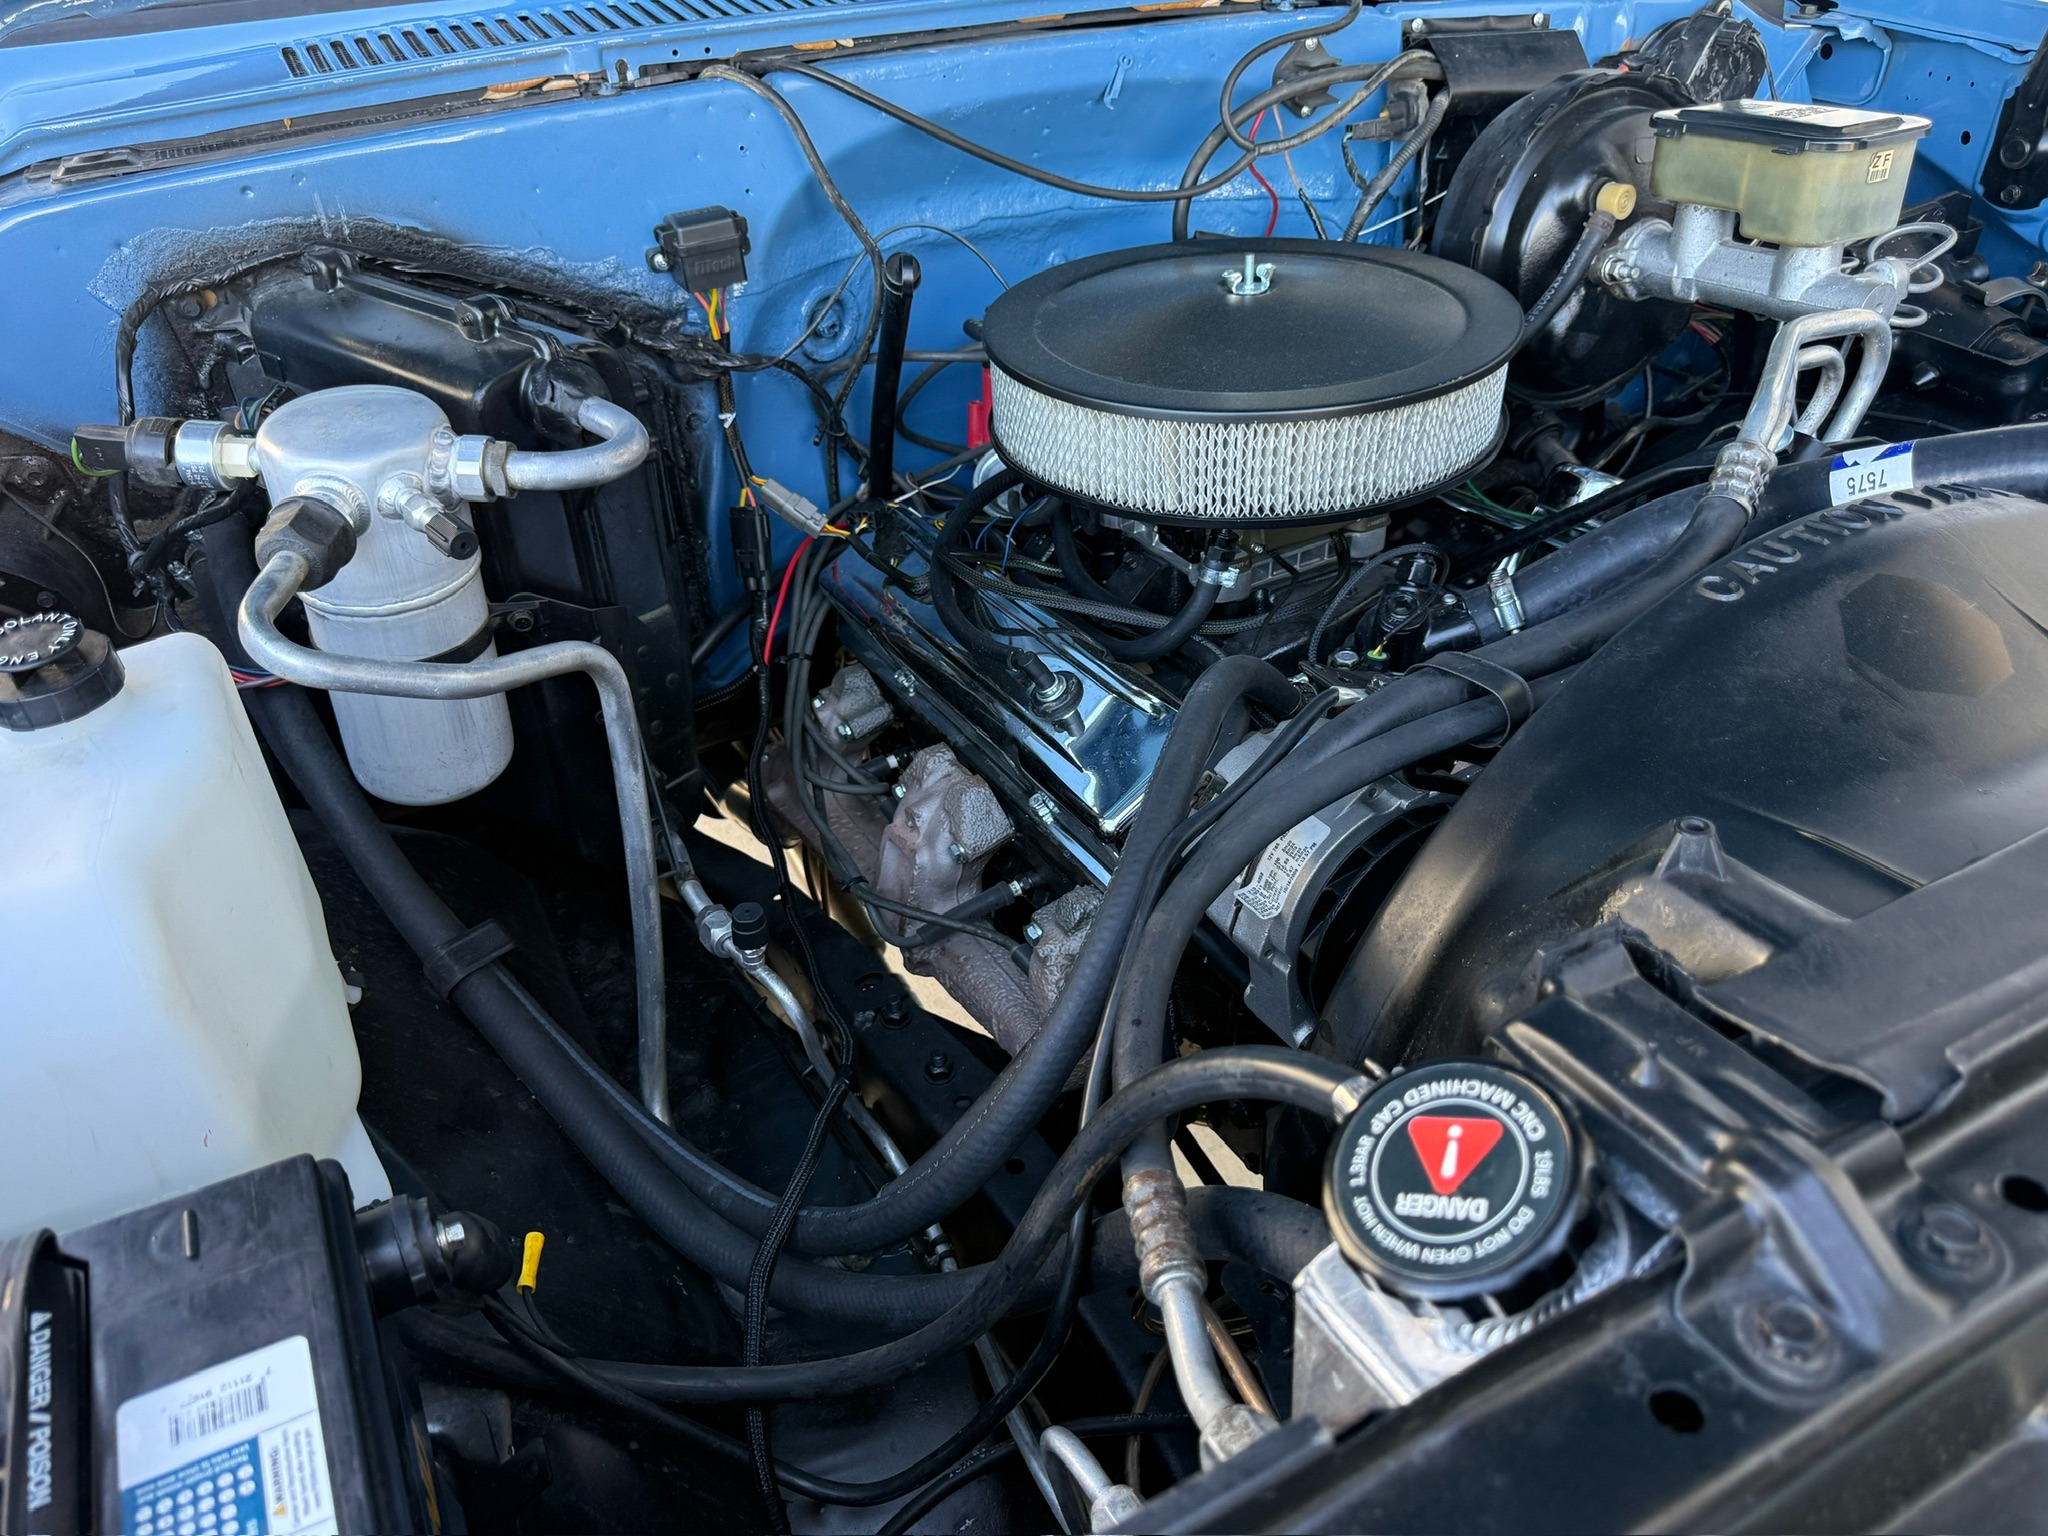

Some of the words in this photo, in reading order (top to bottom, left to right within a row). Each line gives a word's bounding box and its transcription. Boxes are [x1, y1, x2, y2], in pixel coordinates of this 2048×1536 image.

[1847, 469, 1887, 495] 7575
[1697, 499, 1905, 602] CAUTION
[48, 621, 78, 654] ONLY
[1403, 1078, 1517, 1108] MACHINED
[1370, 1099, 1404, 1136] CAP
[1510, 1100, 1548, 1142] CNC
[1530, 1150, 1554, 1200] 19LBS
[1353, 1196, 1379, 1229] HOT
[1394, 1191, 1490, 1223] DANGER
[1508, 1204, 1536, 1236] DO
[1371, 1224, 1420, 1259] WHEN
[1421, 1245, 1474, 1265] OPEN
[1473, 1231, 1513, 1259] NOT
[29, 1328, 52, 1409] DANGER
[28, 1425, 52, 1511] POISON
